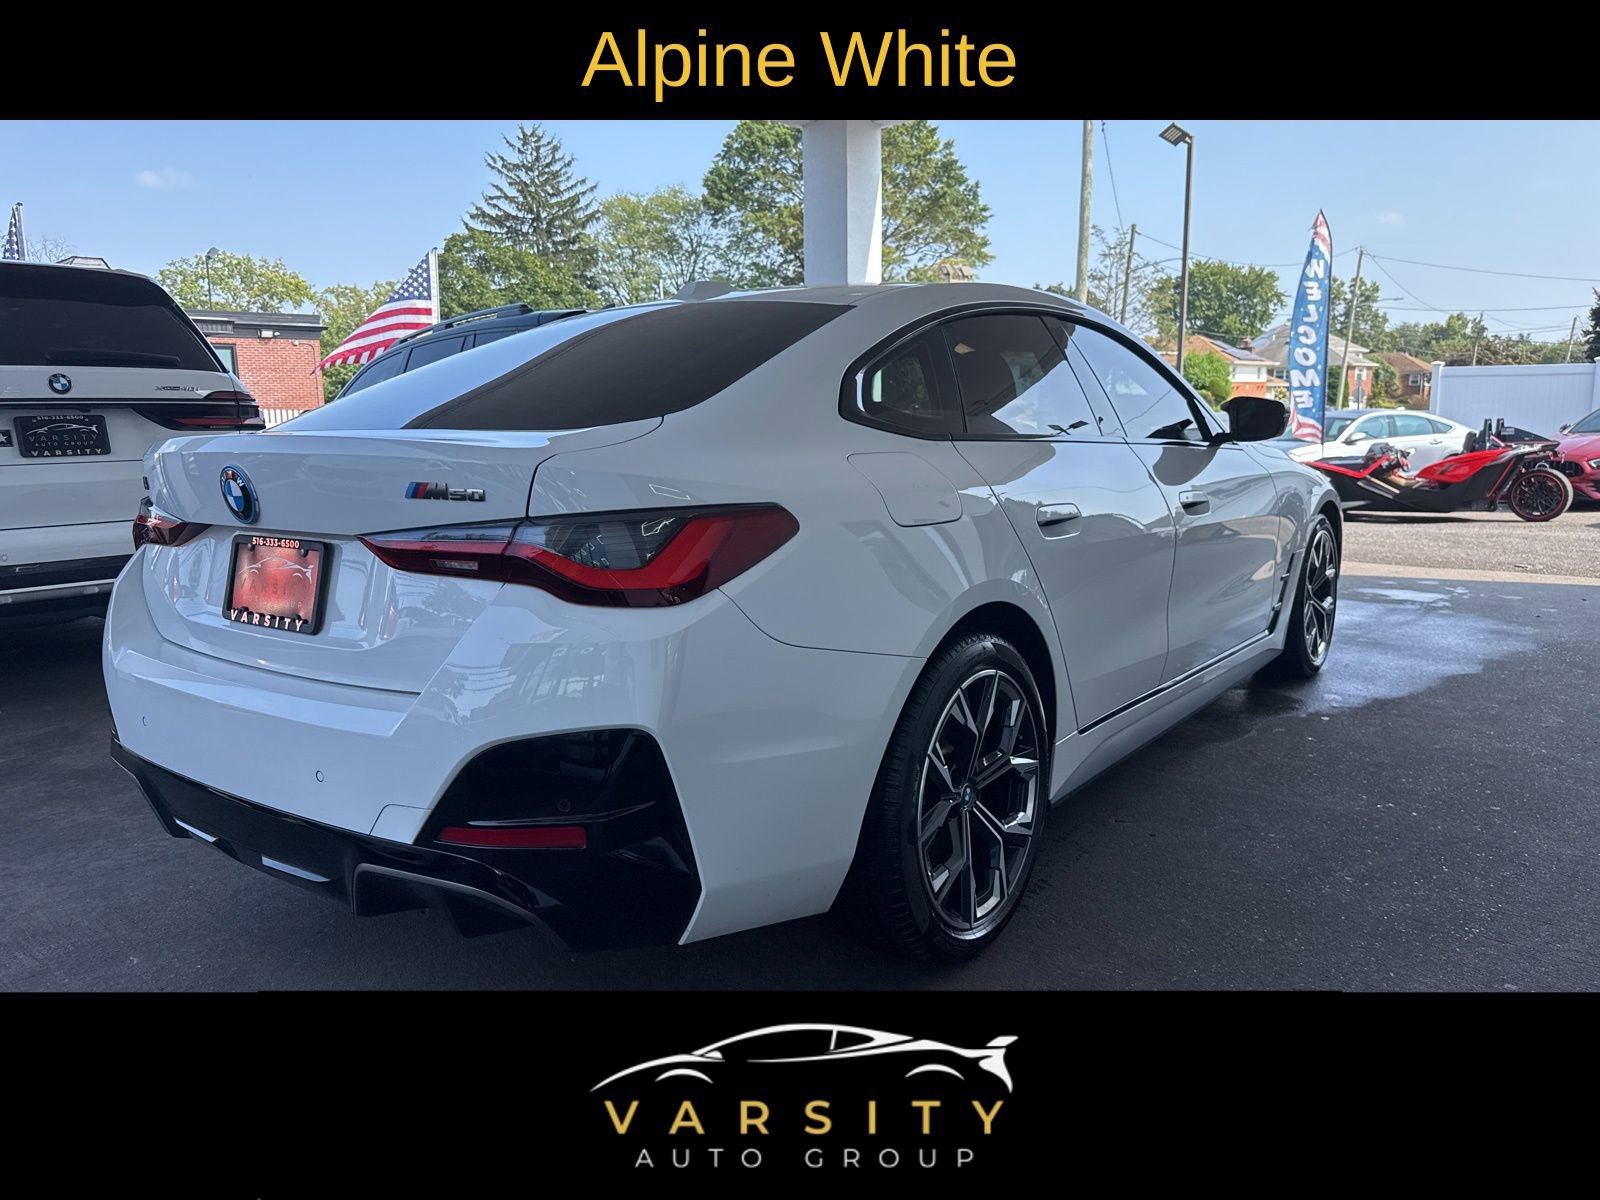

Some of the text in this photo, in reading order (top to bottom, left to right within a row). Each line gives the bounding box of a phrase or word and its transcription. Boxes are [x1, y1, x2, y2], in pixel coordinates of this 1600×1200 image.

[28, 433, 97, 442] VARSITY
[31, 448, 102, 457] VARSITY
[251, 536, 300, 549] 516-333-6500
[240, 577, 307, 599] VARSI
[230, 609, 304, 632] VARSITY
